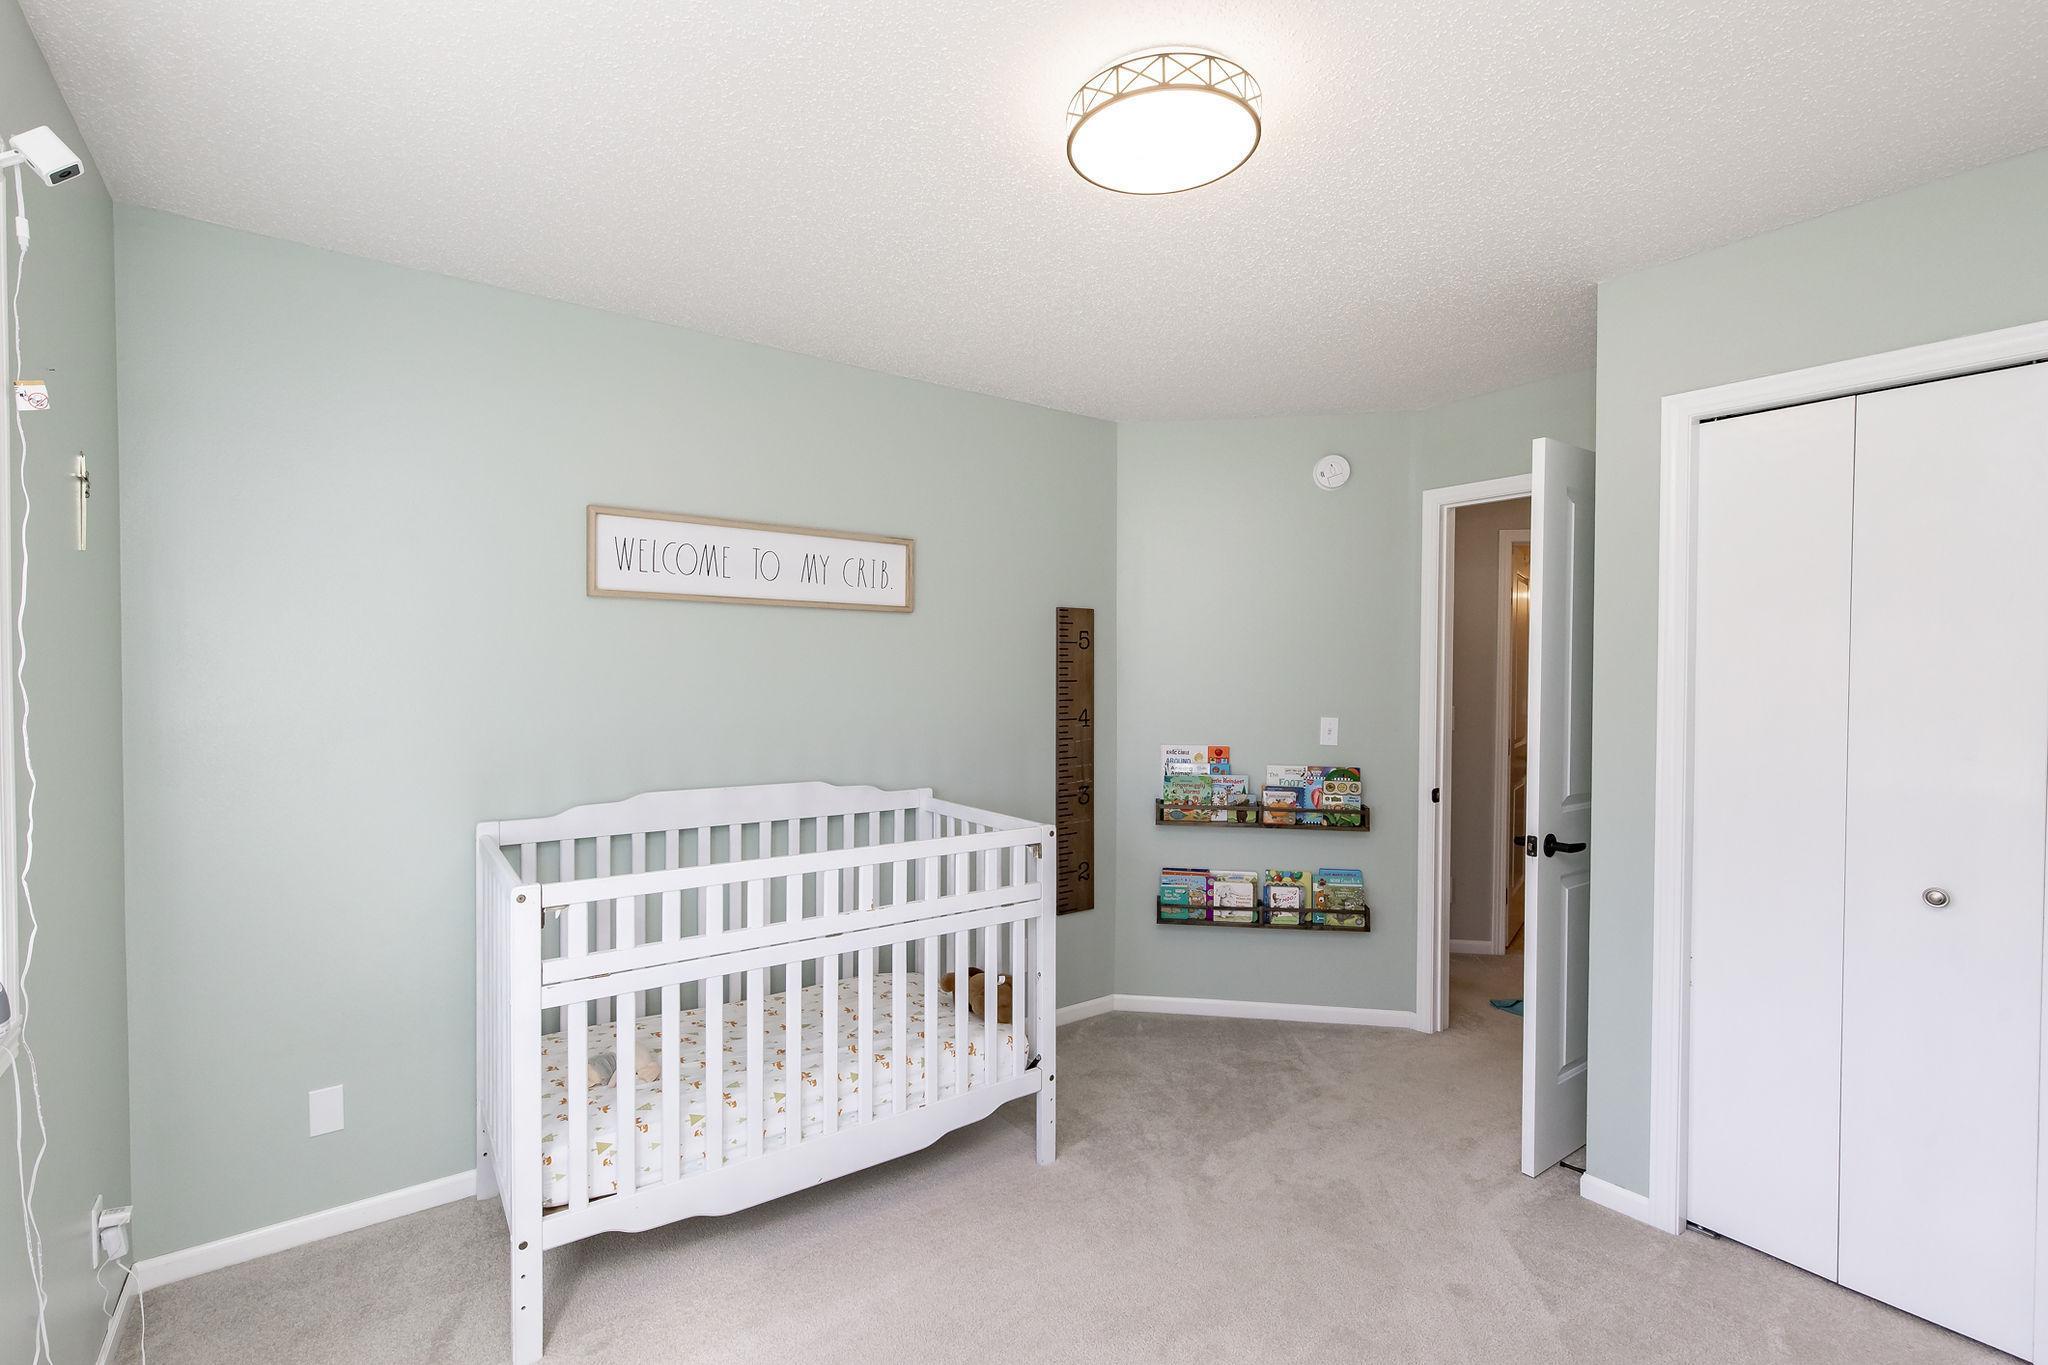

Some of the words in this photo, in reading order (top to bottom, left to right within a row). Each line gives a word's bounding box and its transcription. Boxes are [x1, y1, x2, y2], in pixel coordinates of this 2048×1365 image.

[614, 536, 732, 579] WELCOME
[752, 546, 781, 582] TO
[800, 552, 830, 585] MY
[842, 557, 895, 590] CRIB.
[1078, 630, 1090, 650] 5
[1078, 708, 1090, 728] 4
[1078, 785, 1090, 805] 3
[1078, 861, 1090, 881] 2
